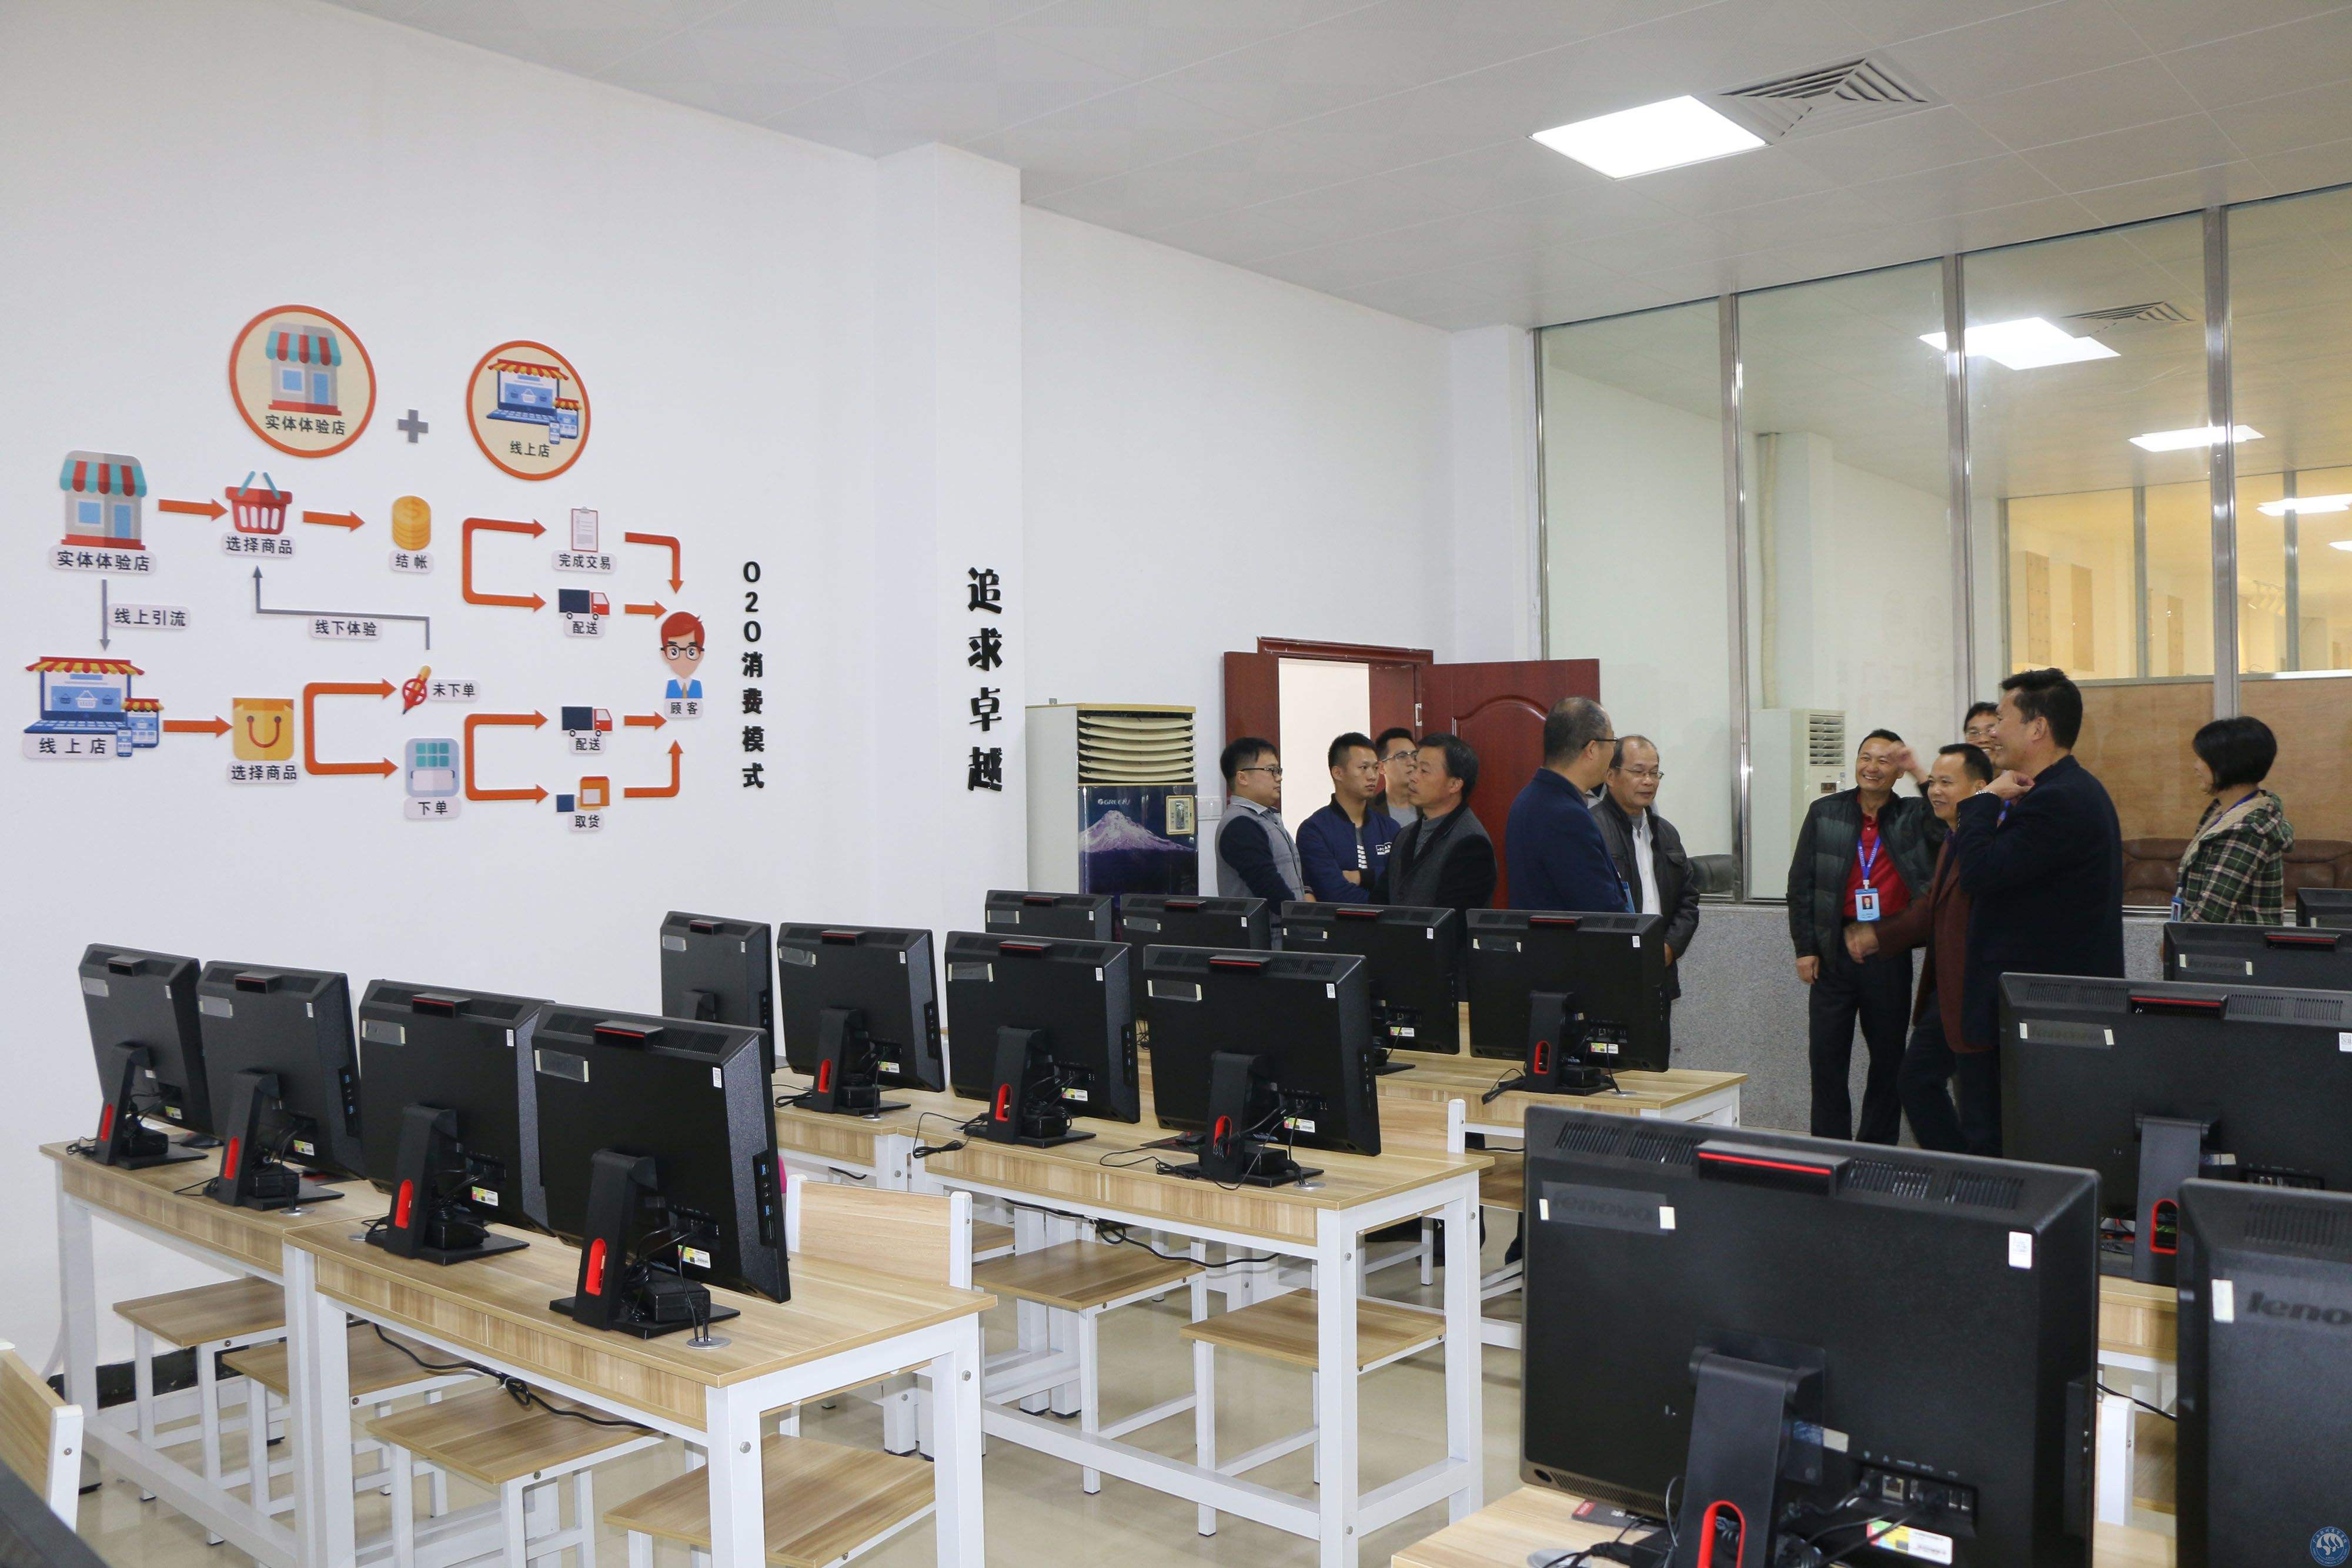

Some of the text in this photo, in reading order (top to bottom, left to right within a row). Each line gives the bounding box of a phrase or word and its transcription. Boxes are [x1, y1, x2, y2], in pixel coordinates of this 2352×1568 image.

[265, 414, 345, 436] 实体体验店
[510, 440, 550, 458] 线上店
[226, 536, 292, 554] 选择商品
[57, 550, 149, 571] 实体体验店
[559, 553, 610, 570] 完成交易
[114, 608, 186, 627] 线上引流
[315, 619, 377, 636] 线下体验
[572, 620, 597, 635] 配送
[967, 567, 1003, 792] 追求卓越
[433, 683, 475, 697] 未下单
[670, 701, 697, 715] 顾客
[39, 738, 106, 754] 线上店
[575, 738, 600, 751] 配送
[231, 765, 296, 780] 选择商品
[418, 801, 447, 815] 下单
[574, 815, 600, 828] 取货
